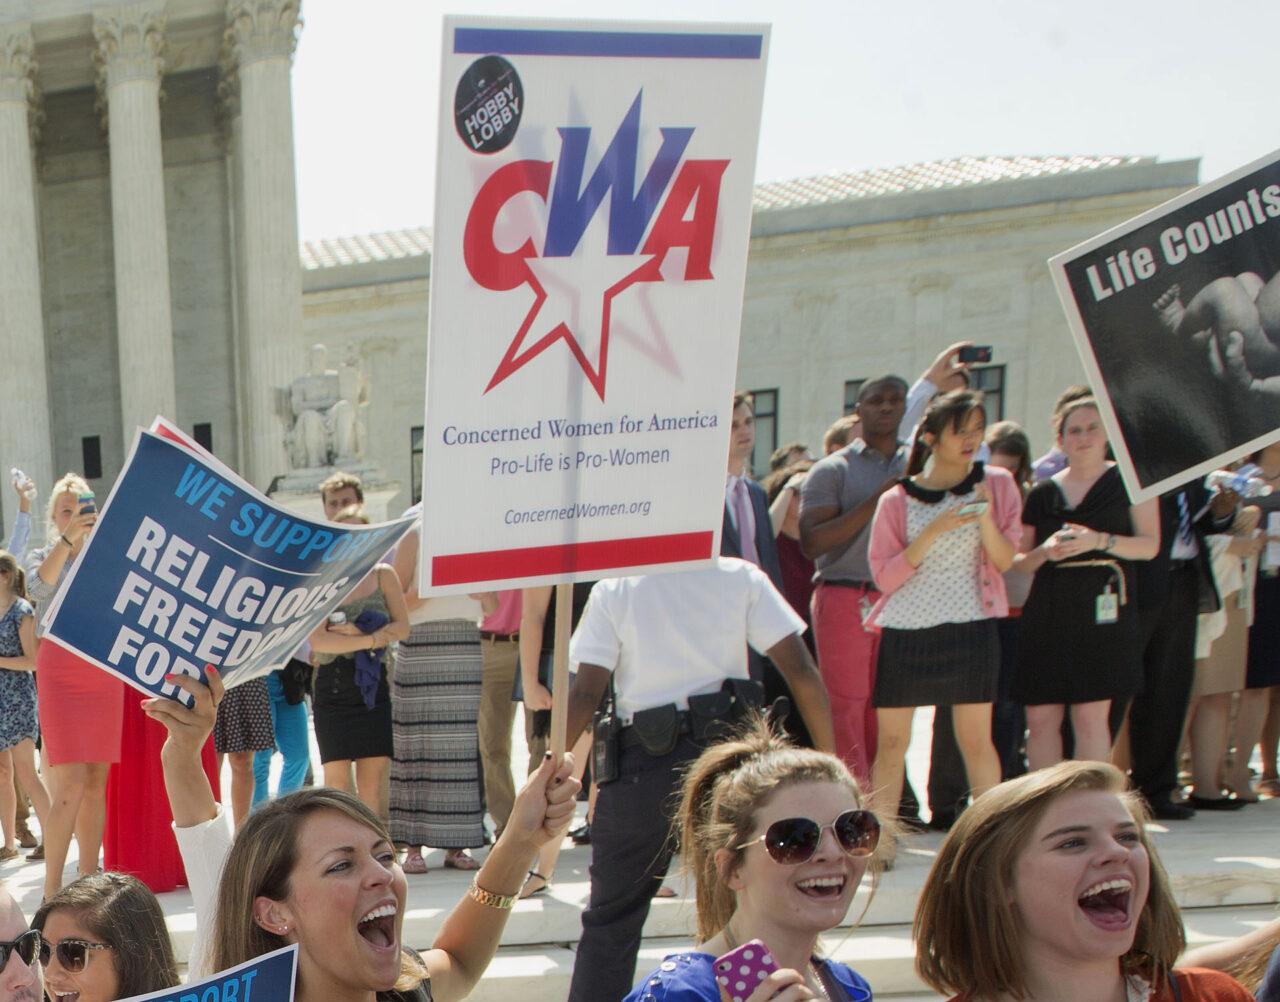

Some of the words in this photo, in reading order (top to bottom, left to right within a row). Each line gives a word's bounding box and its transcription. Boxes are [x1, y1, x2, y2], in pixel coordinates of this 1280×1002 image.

[464, 82, 514, 134] HOBBY
[470, 97, 519, 149] LOBBY
[463, 86, 731, 291] CWA
[1086, 246, 1157, 302] Life
[1159, 184, 1280, 267] Counts
[442, 421, 542, 446] Concerned
[547, 418, 614, 438] Women
[619, 415, 644, 434] for
[647, 410, 718, 432] America
[490, 452, 553, 476] Pro-Life
[559, 453, 571, 470] is
[575, 447, 670, 469] Pro-Women
[174, 462, 236, 520] WE
[229, 502, 386, 564] SUPPORT
[504, 500, 651, 525] ConcernedWomen.org
[125, 515, 350, 626] RELIGIOUS
[107, 624, 202, 706] FOR
